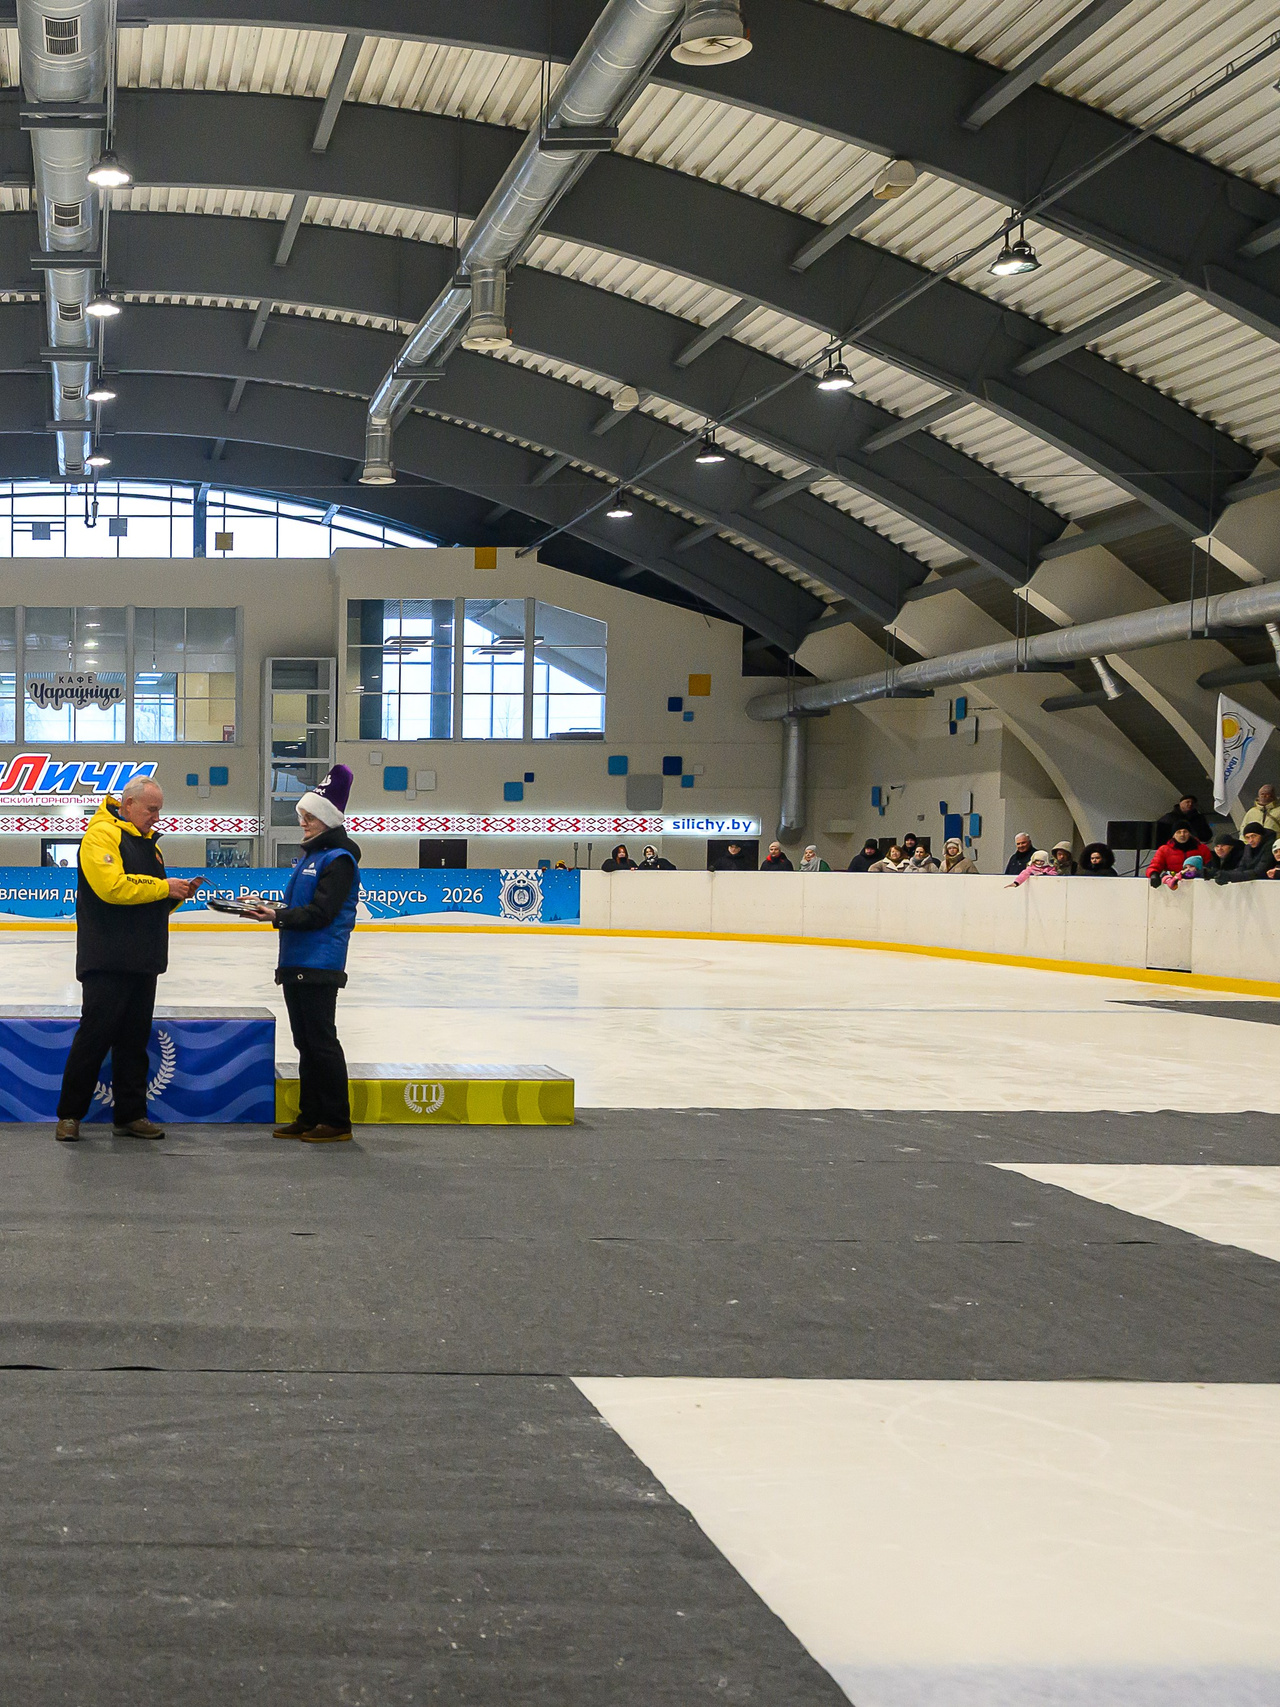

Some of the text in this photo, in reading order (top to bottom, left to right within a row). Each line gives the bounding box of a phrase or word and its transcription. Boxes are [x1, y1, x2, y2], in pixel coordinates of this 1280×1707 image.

[58, 675, 94, 684] КАФЕ
[35, 795, 121, 804] ГОРНОЛЫЖН
[672, 818, 753, 833] silichy.by
[358, 887, 484, 906] еларусь 2026
[411, 1084, 438, 1102] III
